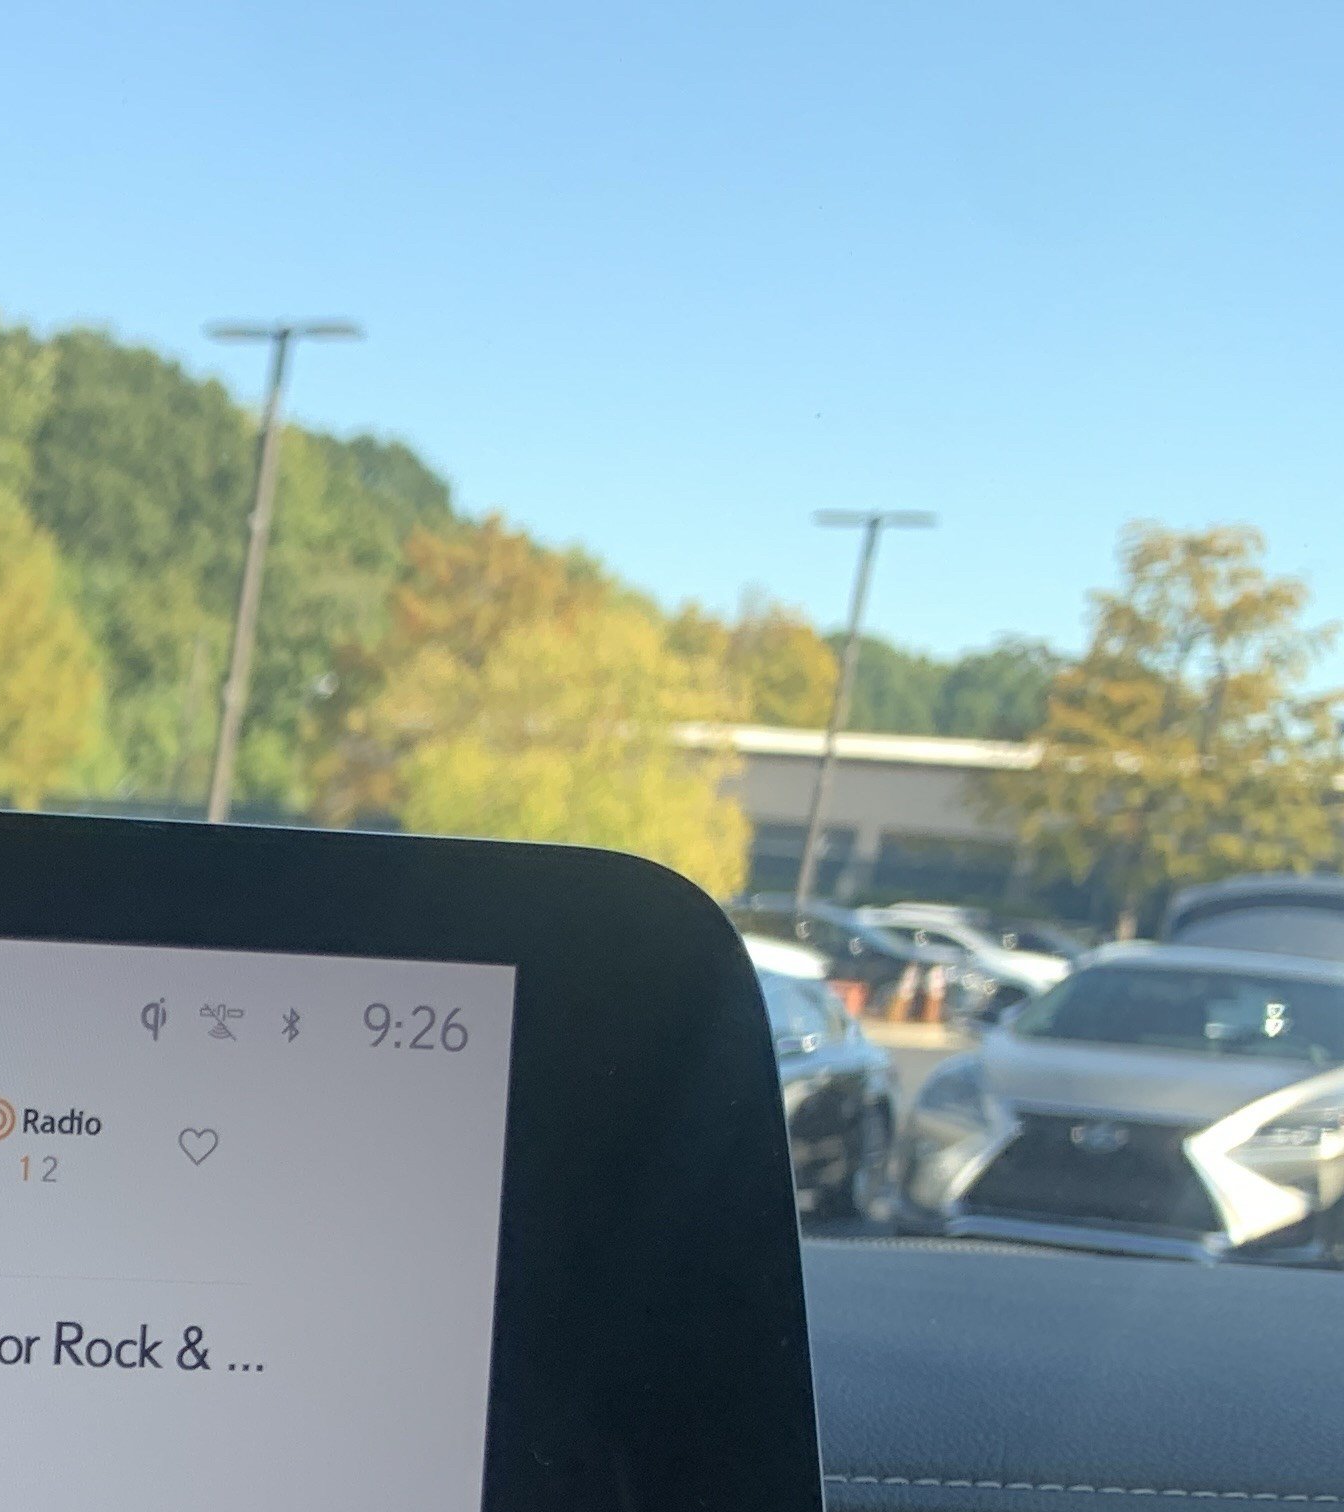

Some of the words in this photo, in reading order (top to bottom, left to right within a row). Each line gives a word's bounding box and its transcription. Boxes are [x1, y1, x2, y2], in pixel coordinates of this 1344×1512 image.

[364, 1003, 468, 1052] 9:26
[23, 1109, 101, 1135] Radio
[21, 1156, 29, 1181] 1
[42, 1155, 58, 1182] 2
[54, 1321, 162, 1368] Rock
[177, 1326, 210, 1370] &
